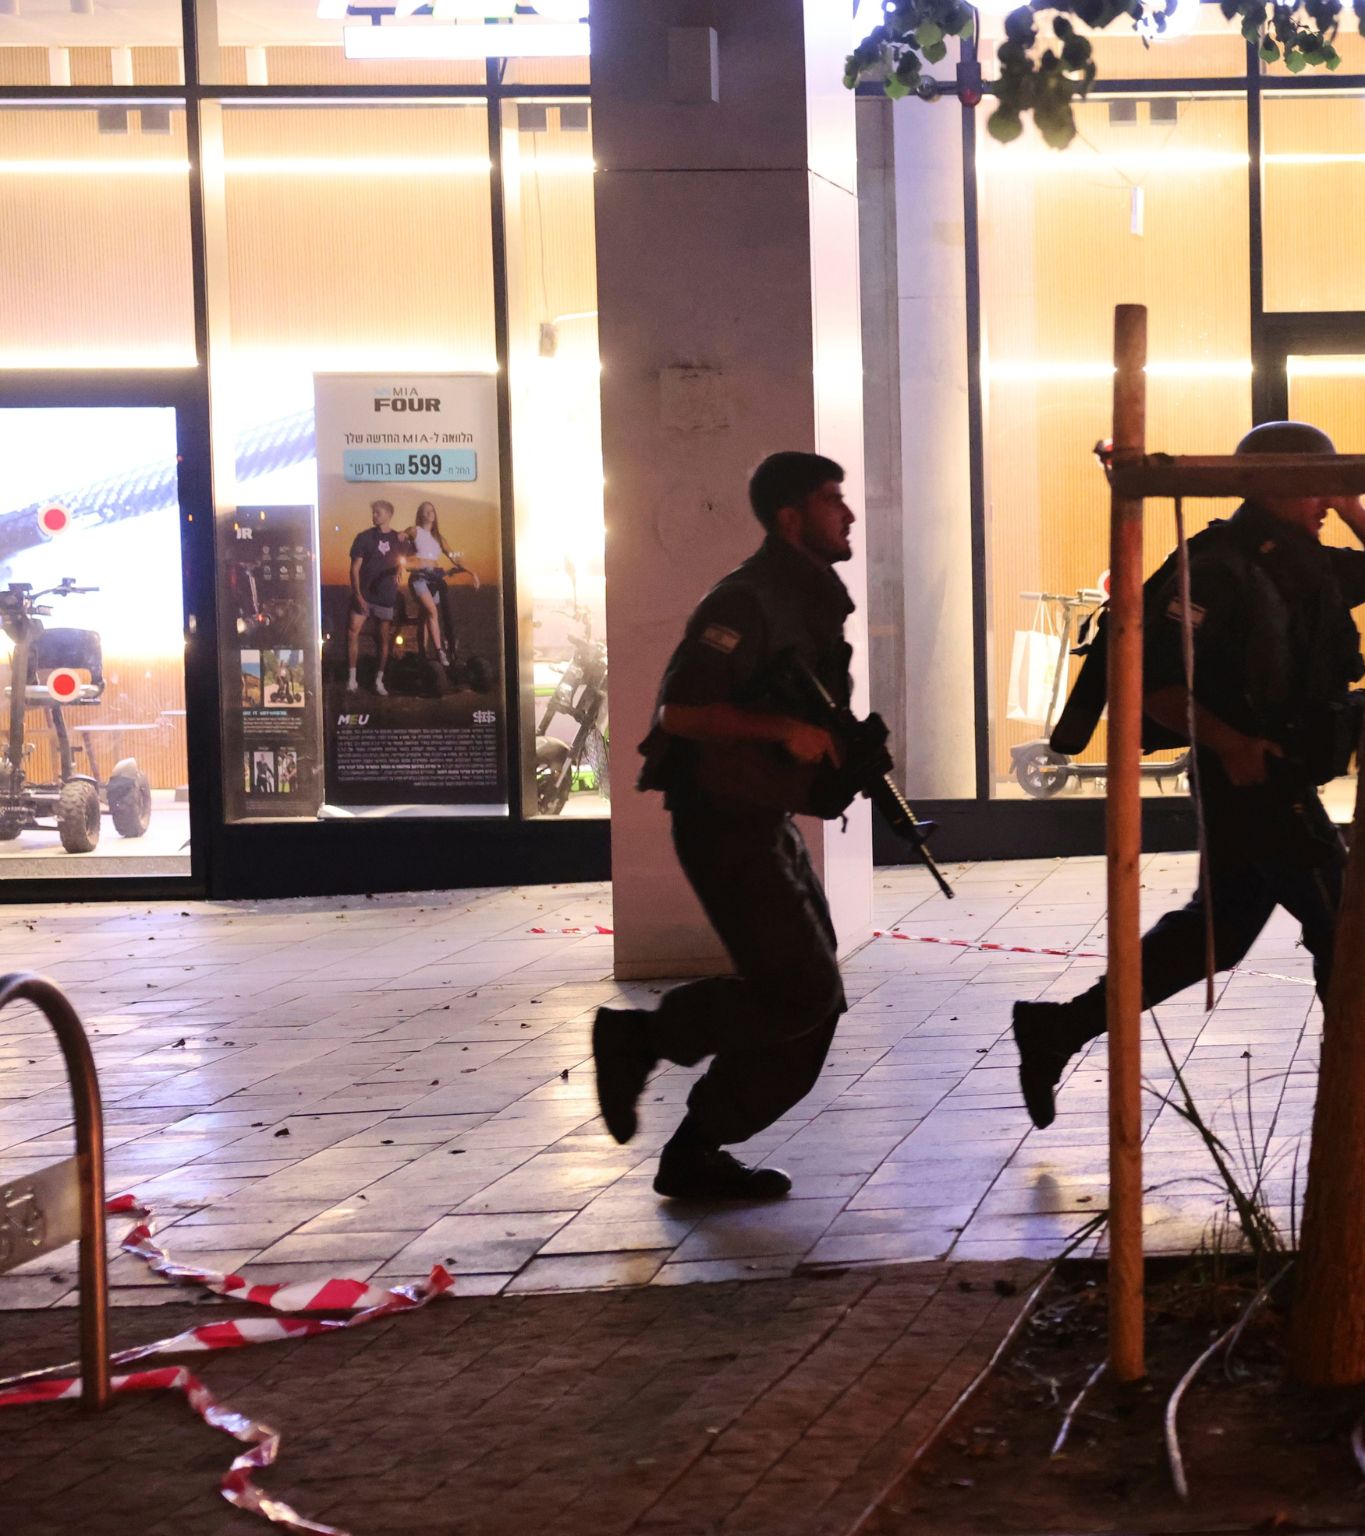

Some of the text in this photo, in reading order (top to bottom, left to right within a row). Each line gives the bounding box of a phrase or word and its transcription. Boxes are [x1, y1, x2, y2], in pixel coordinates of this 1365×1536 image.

[392, 387, 419, 396] MIA
[374, 398, 441, 412] FOUR
[344, 433, 364, 445] שלך
[366, 433, 400, 443] החדשה
[442, 433, 473, 443] הלוואה
[408, 454, 442, 476] 599
